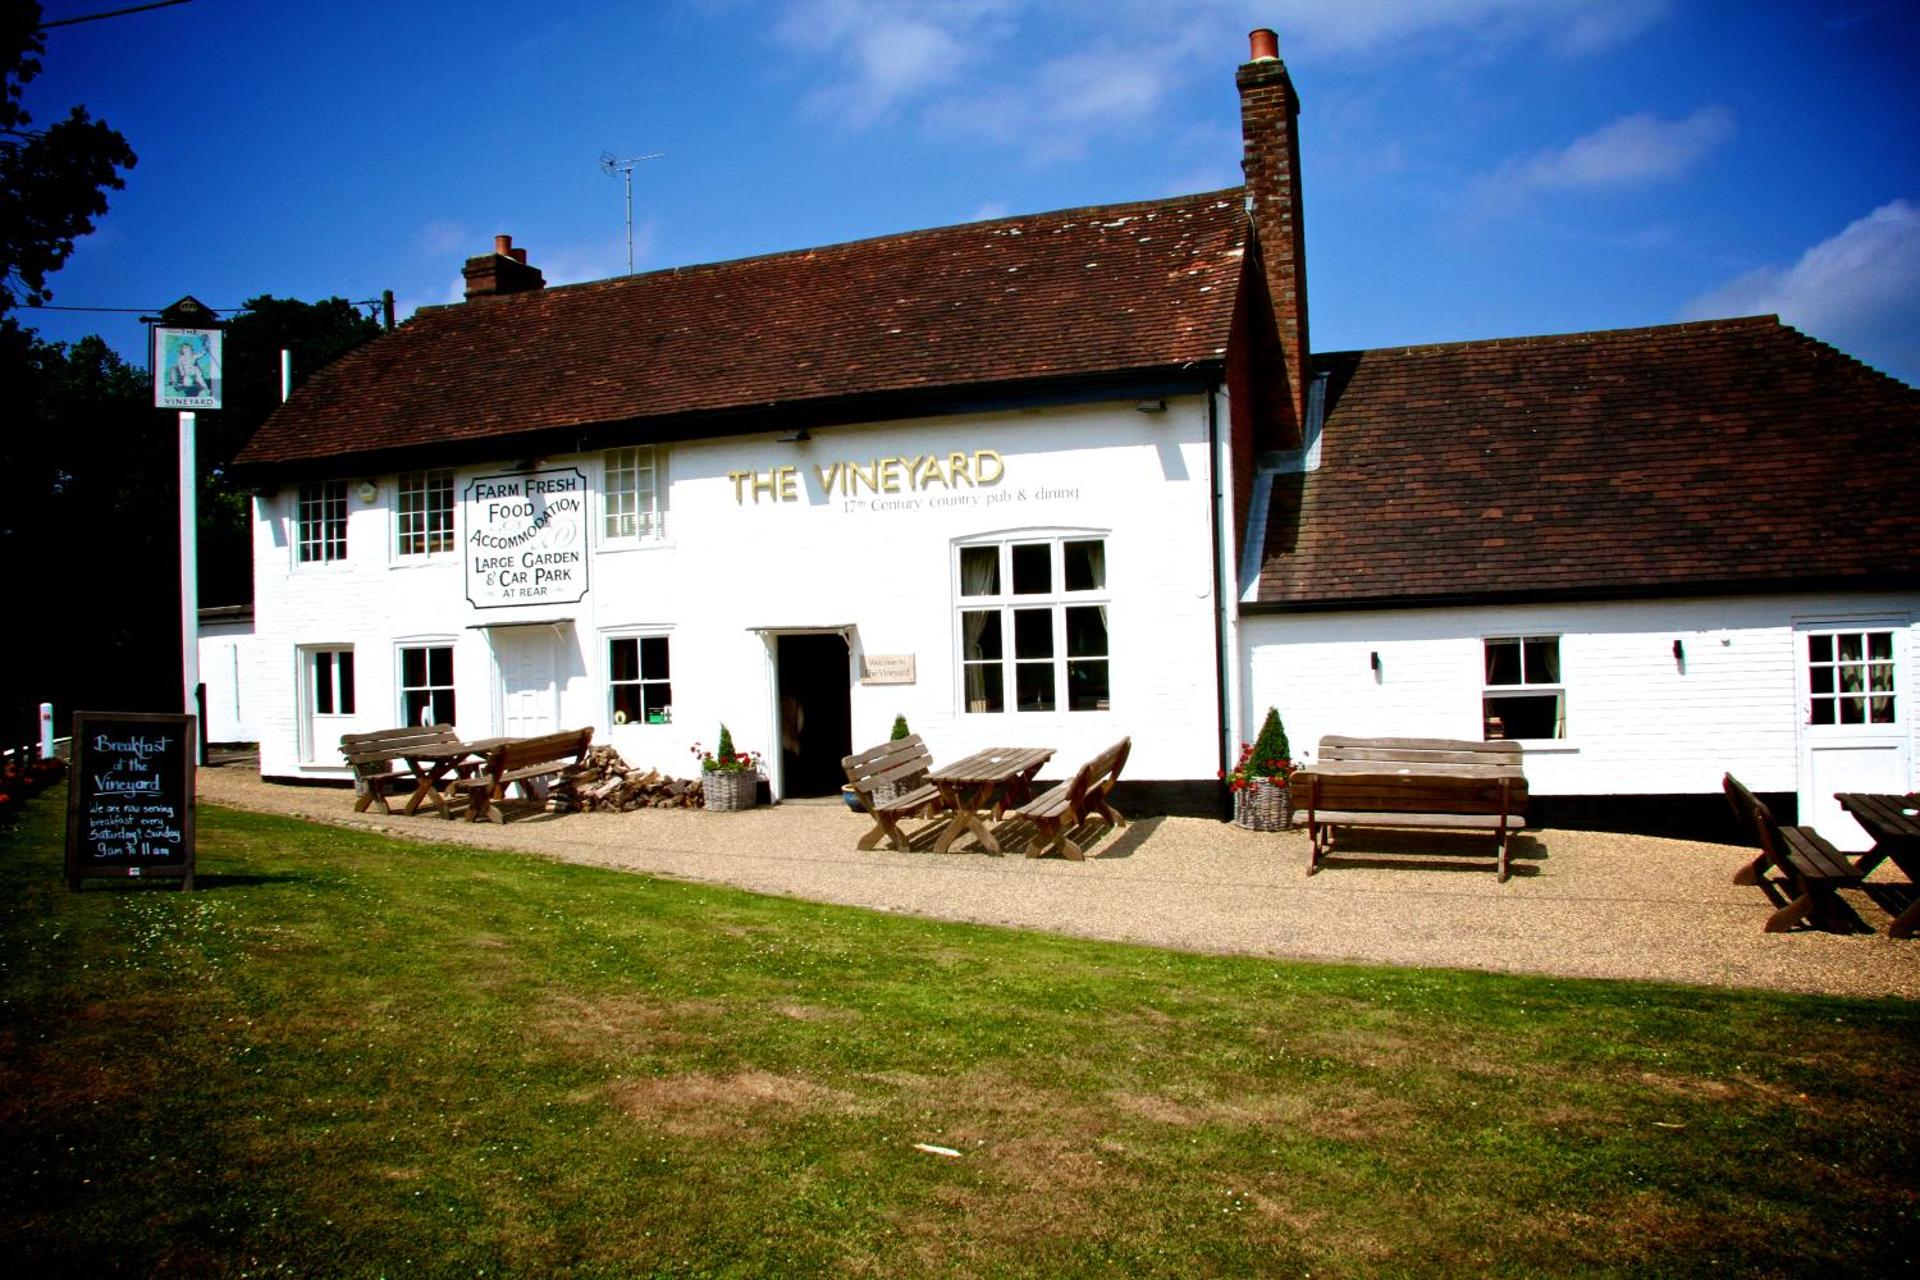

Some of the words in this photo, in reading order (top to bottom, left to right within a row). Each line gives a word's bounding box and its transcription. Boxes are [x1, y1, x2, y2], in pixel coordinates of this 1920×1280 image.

[165, 398, 214, 406] VINEYARD
[728, 465, 798, 505] THE
[813, 449, 1004, 496] VINEYARD
[475, 483, 519, 504] FARM
[526, 478, 576, 498] FRESH
[871, 497, 923, 514] Century
[929, 493, 981, 509] country
[986, 488, 1012, 507] pub
[1017, 487, 1028, 501] &
[1035, 485, 1080, 501] dining
[489, 502, 535, 523] FOOD
[470, 498, 580, 549] ACCOMMODATION
[475, 556, 515, 573] LARGE
[521, 552, 580, 569] GARDEN
[486, 571, 496, 586] &
[499, 570, 528, 587] CAR
[535, 567, 572, 585] PARK
[502, 588, 516, 598] AT
[519, 586, 548, 597] REAR
[93, 734, 174, 760] Breakfast
[128, 757, 148, 771] the
[94, 771, 160, 799] Vineyard
[89, 801, 104, 814] We
[106, 804, 120, 813] are
[123, 804, 141, 813] now
[143, 804, 175, 818] serving
[90, 813, 134, 829] breakfast
[141, 818, 165, 829] every
[144, 825, 181, 843] Sunday
